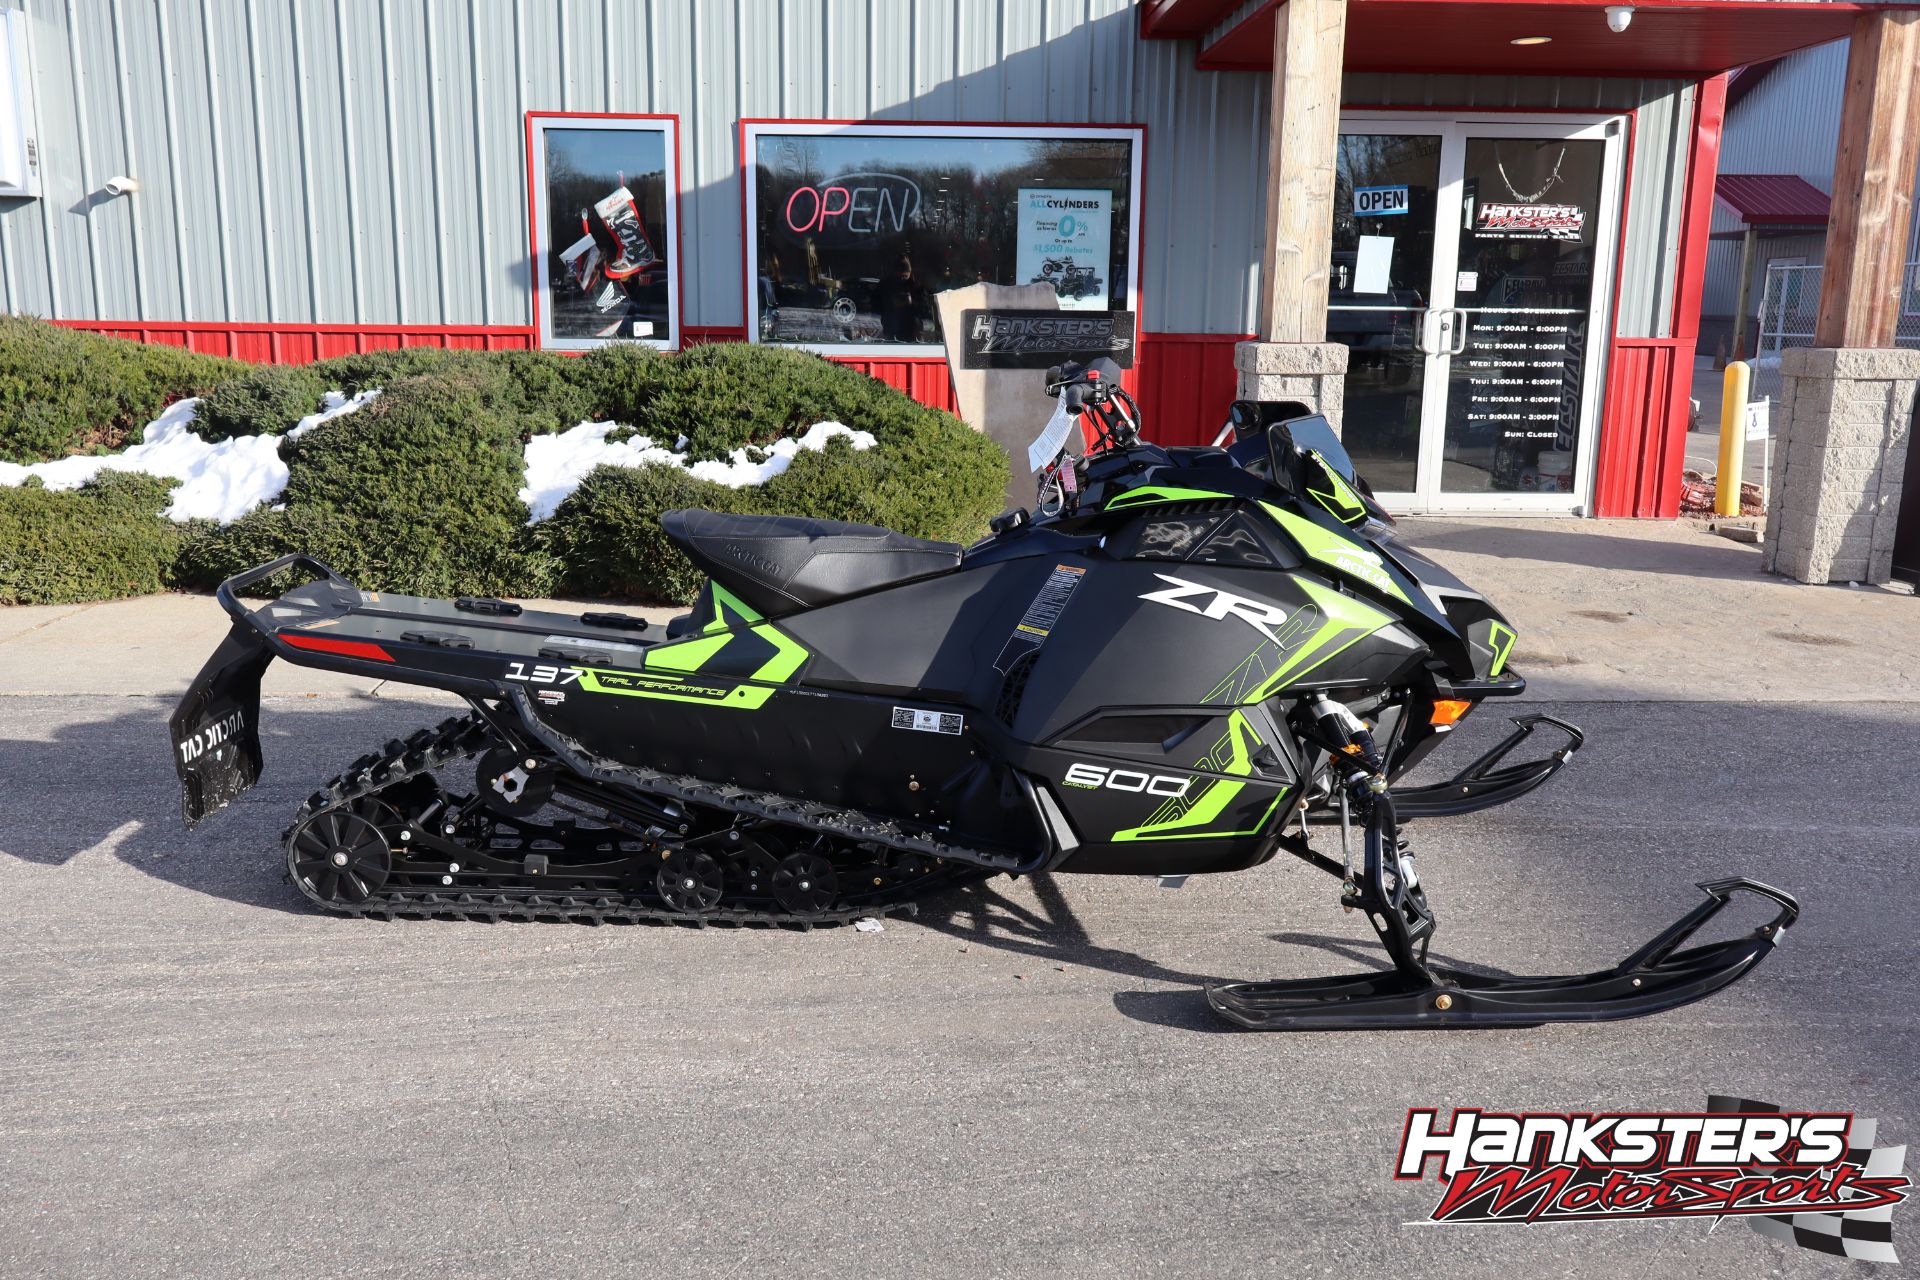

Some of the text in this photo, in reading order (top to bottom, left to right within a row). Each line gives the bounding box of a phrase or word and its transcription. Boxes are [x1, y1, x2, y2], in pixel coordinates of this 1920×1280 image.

[786, 186, 909, 233] OPEN
[1359, 191, 1404, 210] OPEN
[1480, 204, 1570, 218] HANKSTER'S
[600, 295, 627, 314] HONDA
[972, 315, 1114, 339] HANKSTER'S
[1554, 328, 1583, 452] ECSTAR
[1335, 556, 1373, 581] ARCTIC
[1137, 573, 1288, 651] ZR
[505, 662, 583, 685] 137
[601, 676, 726, 697] TRAIL PERFORMANCE
[1062, 780, 1098, 791] CATALYST
[1065, 763, 1191, 797] 600
